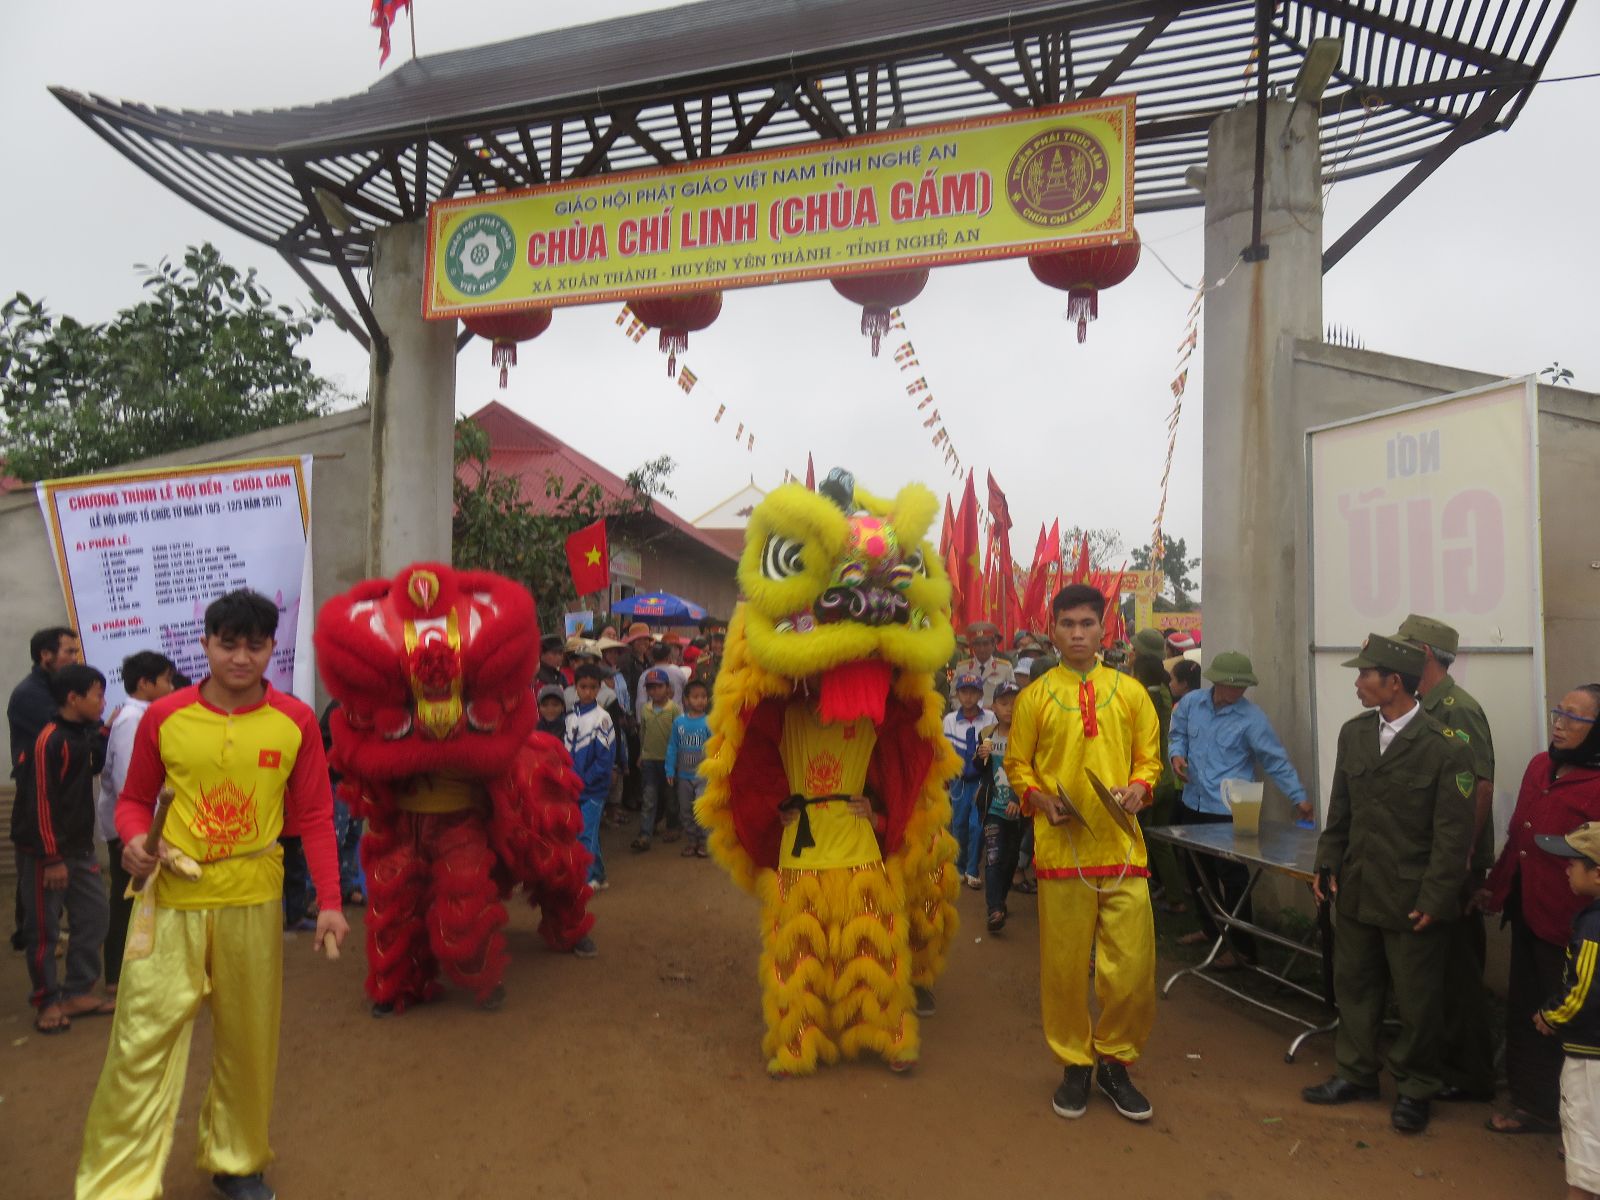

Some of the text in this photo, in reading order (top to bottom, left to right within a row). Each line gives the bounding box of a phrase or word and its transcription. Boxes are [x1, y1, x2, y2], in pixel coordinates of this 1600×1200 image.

[555, 143, 957, 216] GIÁO HỘI PHẬT GIÁO VIỆT NAM TỈNH NGHỆ AN
[527, 167, 994, 269] CHÙA CHÍ LINH (CHÙA GÁM)
[532, 279, 552, 294] XÃ
[558, 272, 599, 291] XUÂN
[604, 266, 657, 286] THÀNH
[671, 255, 727, 277] HUYỆN
[733, 252, 767, 270] YÊN
[771, 245, 831, 266] THÀNH
[846, 237, 889, 257] TỈNH
[896, 228, 948, 251] NGHỆ
[953, 227, 981, 245] AN
[69, 491, 119, 512] CHƯƠNG
[122, 487, 157, 505] TRÌNH
[160, 480, 173, 501] LỄ
[176, 482, 197, 501] HỘI
[266, 473, 291, 488] GÁM
